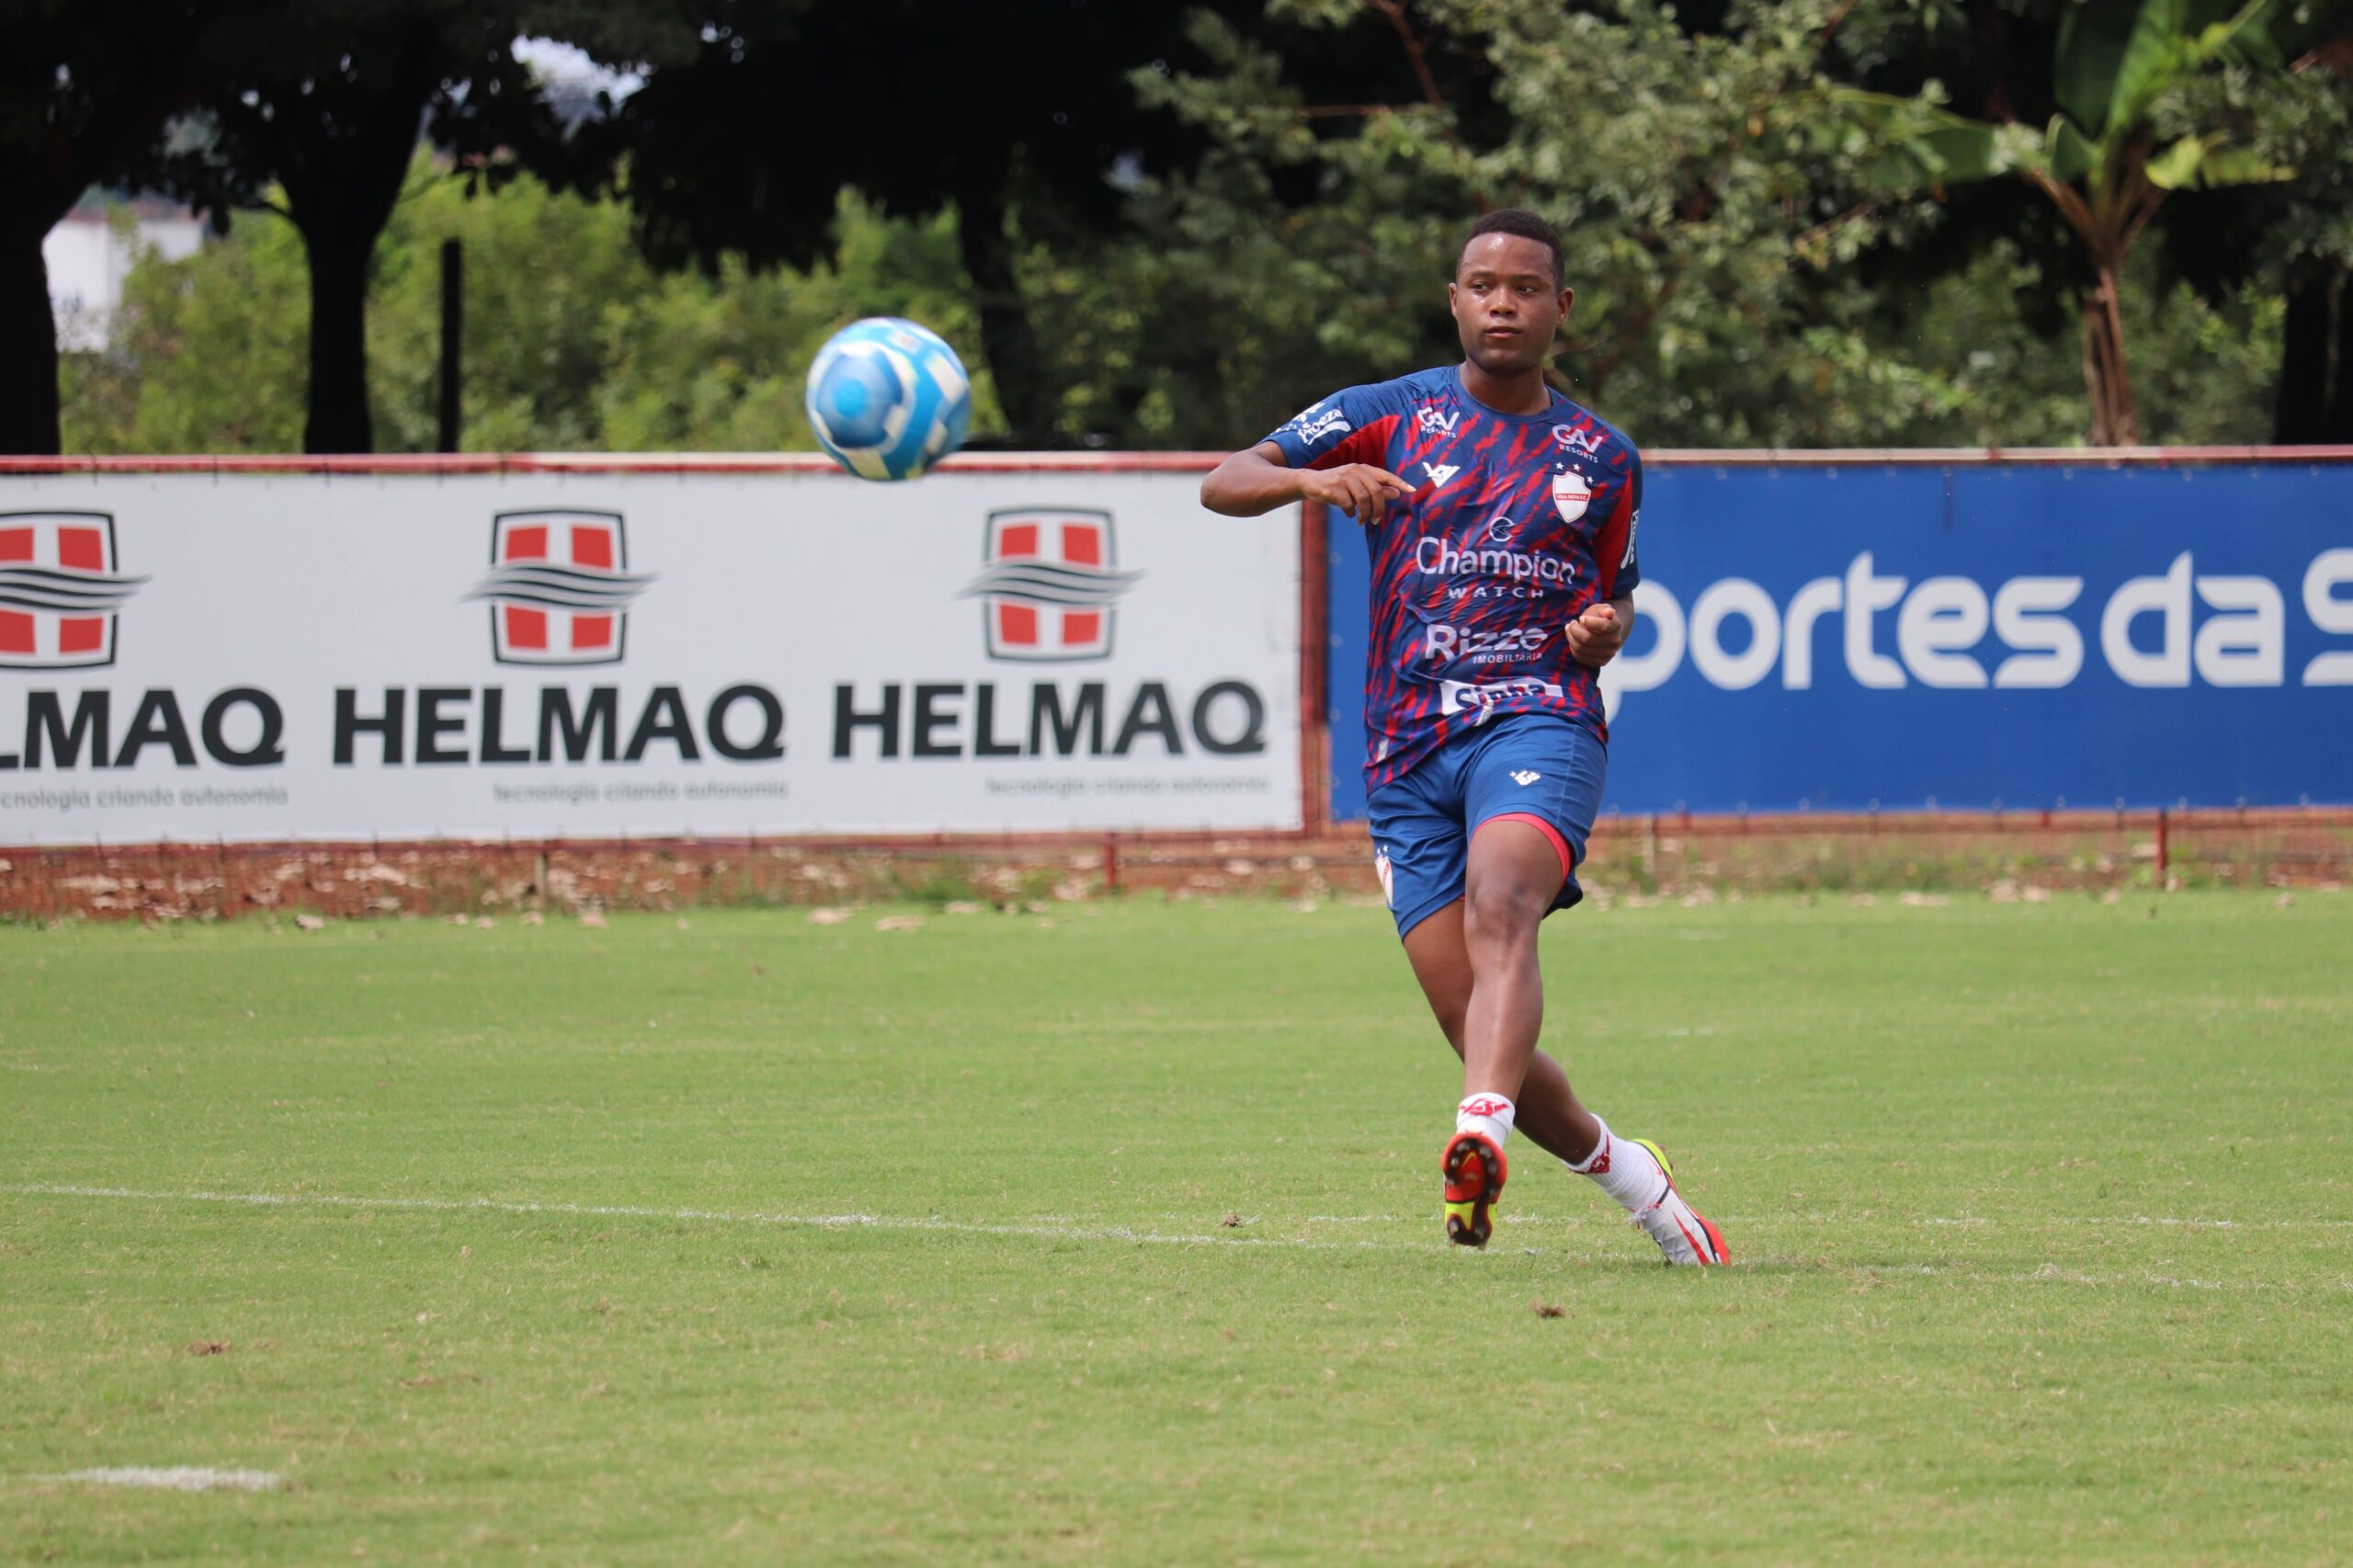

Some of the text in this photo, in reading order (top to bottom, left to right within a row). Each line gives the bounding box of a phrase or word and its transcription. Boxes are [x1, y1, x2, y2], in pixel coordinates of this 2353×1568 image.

[1417, 407, 1460, 431] GAV
[1552, 424, 1603, 453] GAV
[1559, 444, 1599, 463] RESORTS
[1415, 536, 1576, 585] Champion
[1448, 585, 1544, 600] WATCH
[2100, 551, 2286, 687] da
[1425, 623, 1549, 664] Rizzo
[0, 686, 286, 772] MAQ
[332, 683, 786, 768] HELMAQ
[831, 679, 1267, 760] HELMAQ
